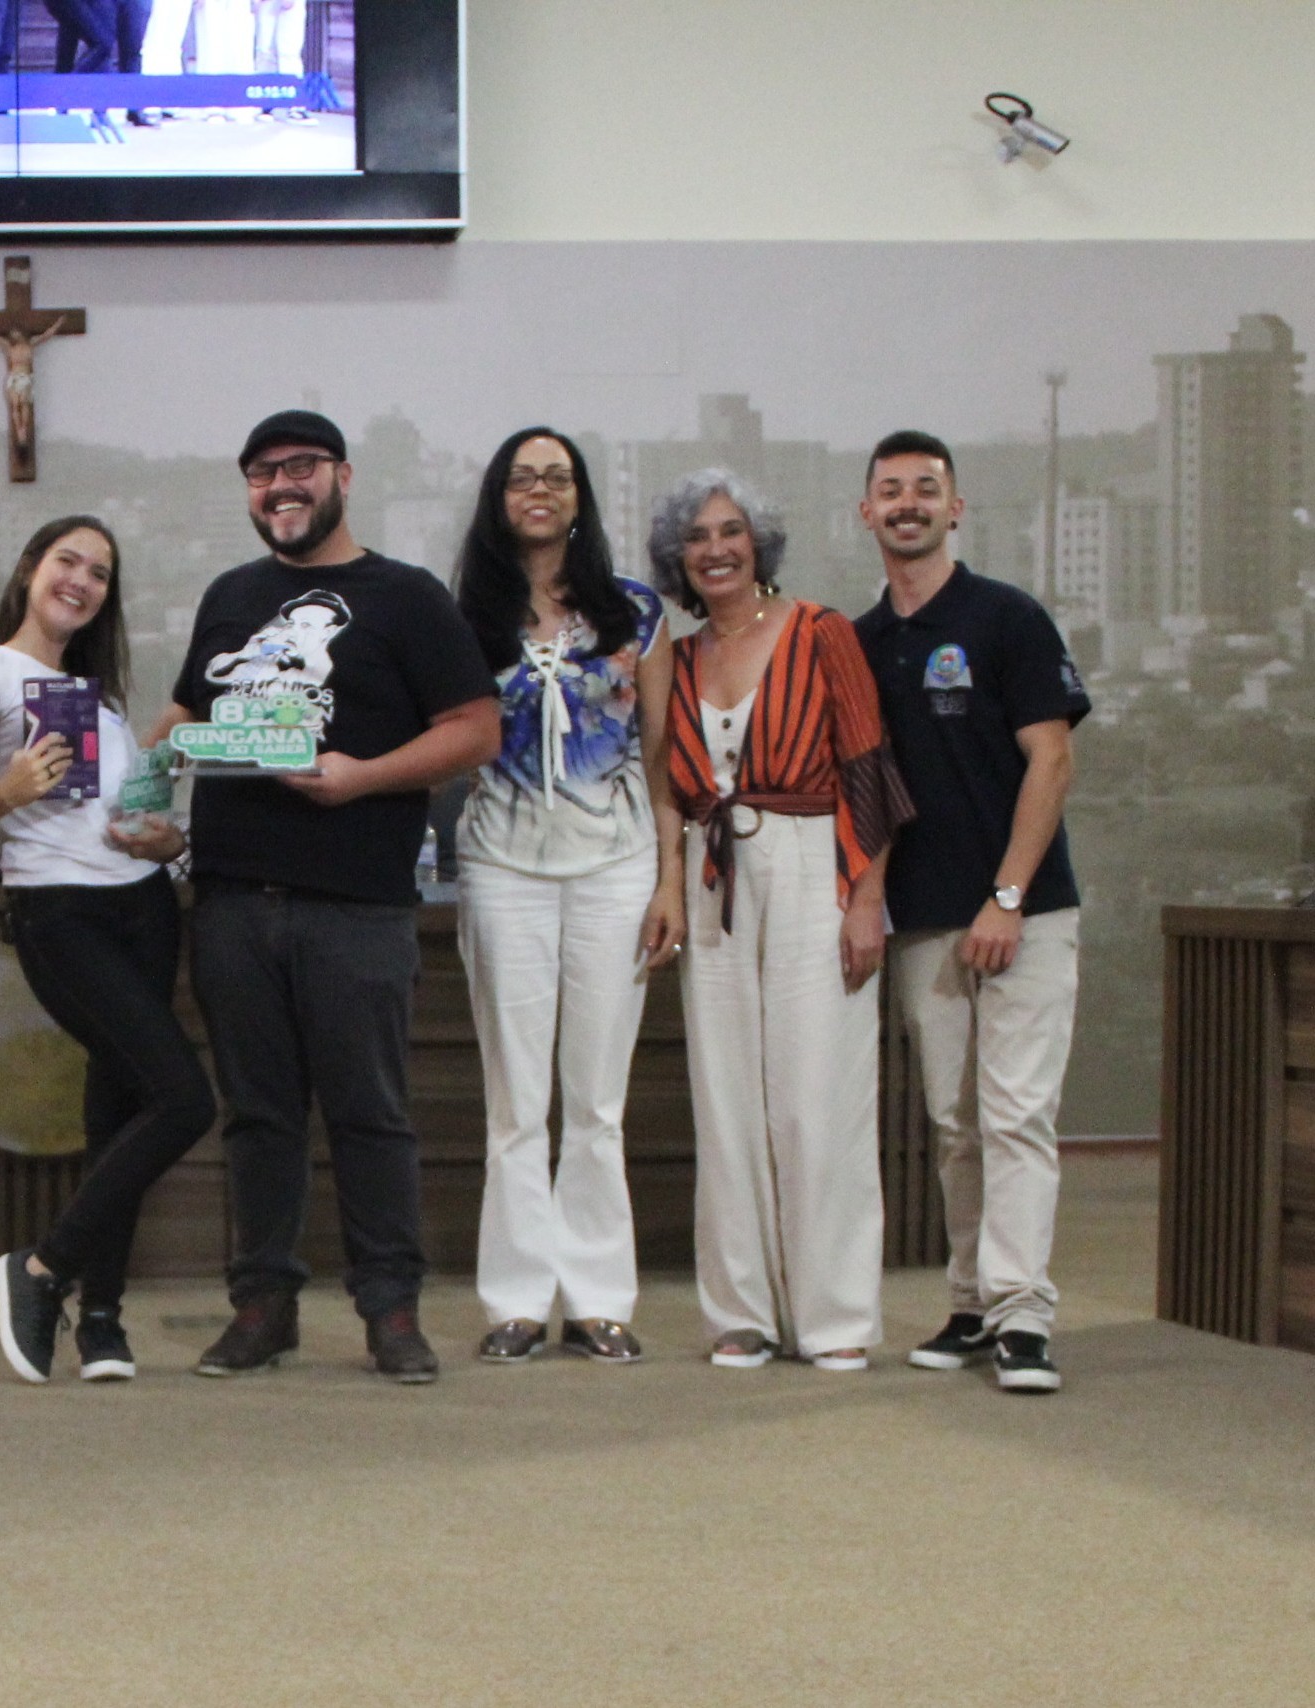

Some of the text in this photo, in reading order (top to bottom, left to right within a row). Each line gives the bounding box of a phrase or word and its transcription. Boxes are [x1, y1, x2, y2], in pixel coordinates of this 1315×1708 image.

[179, 728, 306, 745] GINCANA
[226, 742, 307, 755] DO SABER
